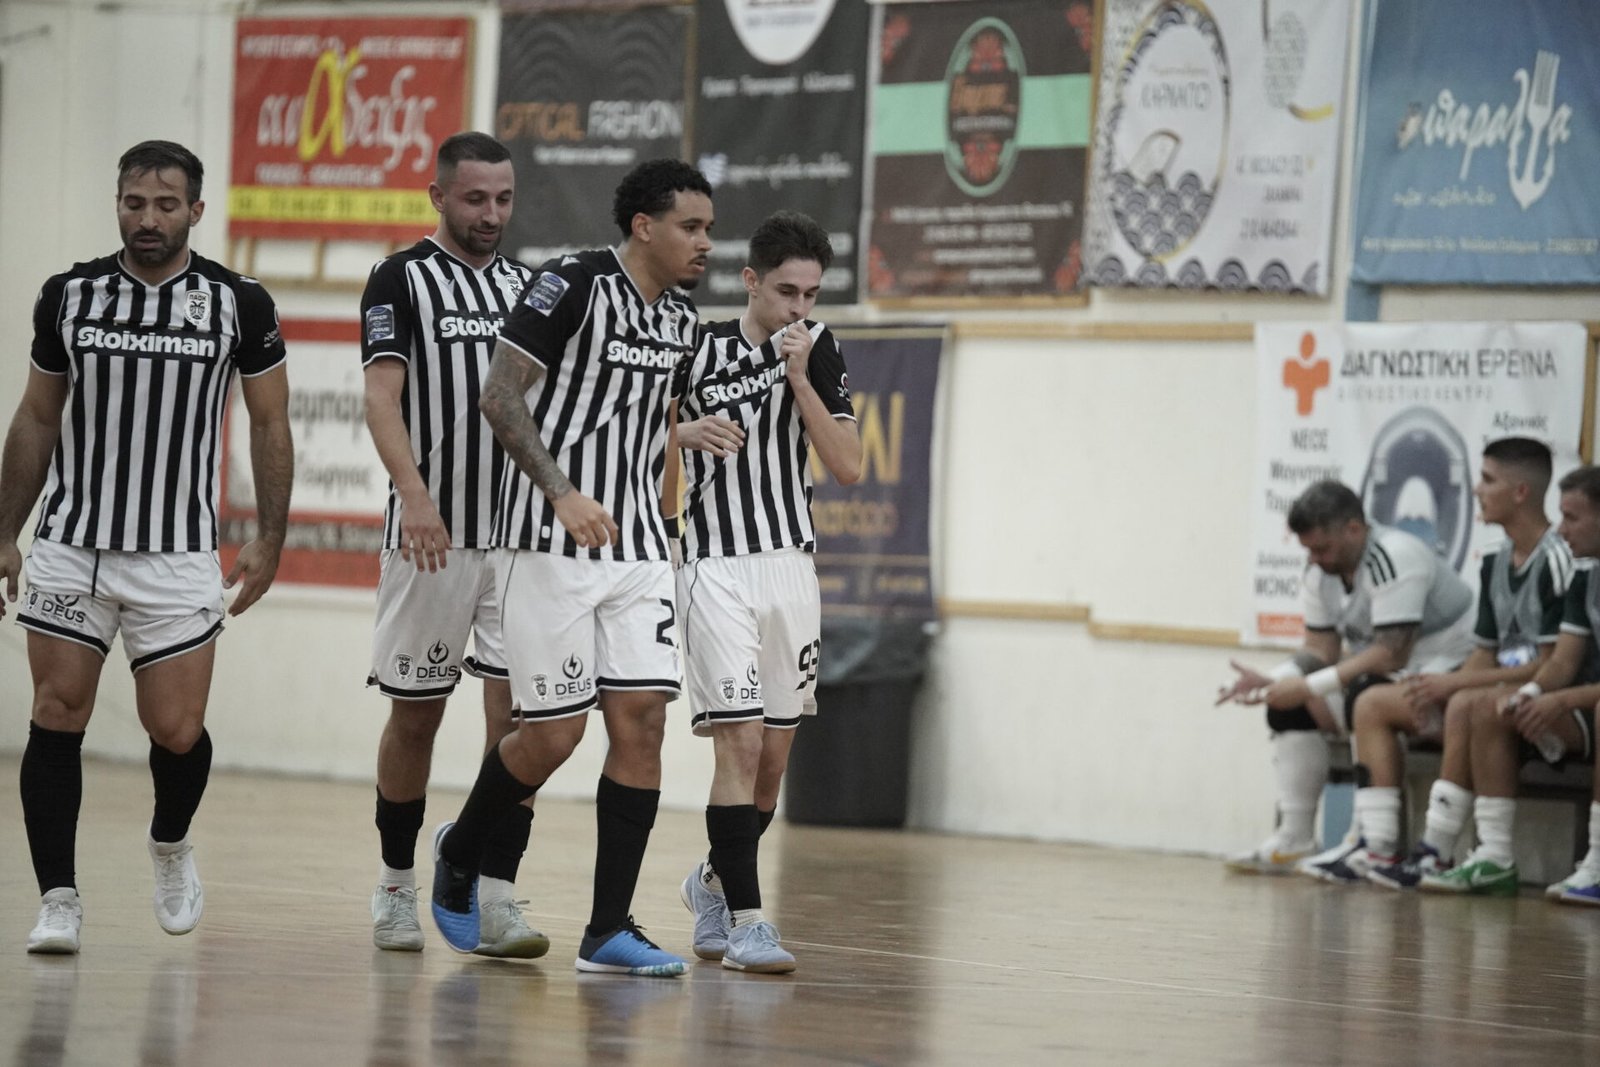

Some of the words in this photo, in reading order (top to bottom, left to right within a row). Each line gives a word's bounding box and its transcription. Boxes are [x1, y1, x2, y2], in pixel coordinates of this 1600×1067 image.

[76, 325, 216, 358] Stoiximan
[41, 599, 87, 624] DEUS
[416, 664, 459, 679] DEUS
[554, 677, 592, 696] DEUS
[740, 687, 762, 700] DE
